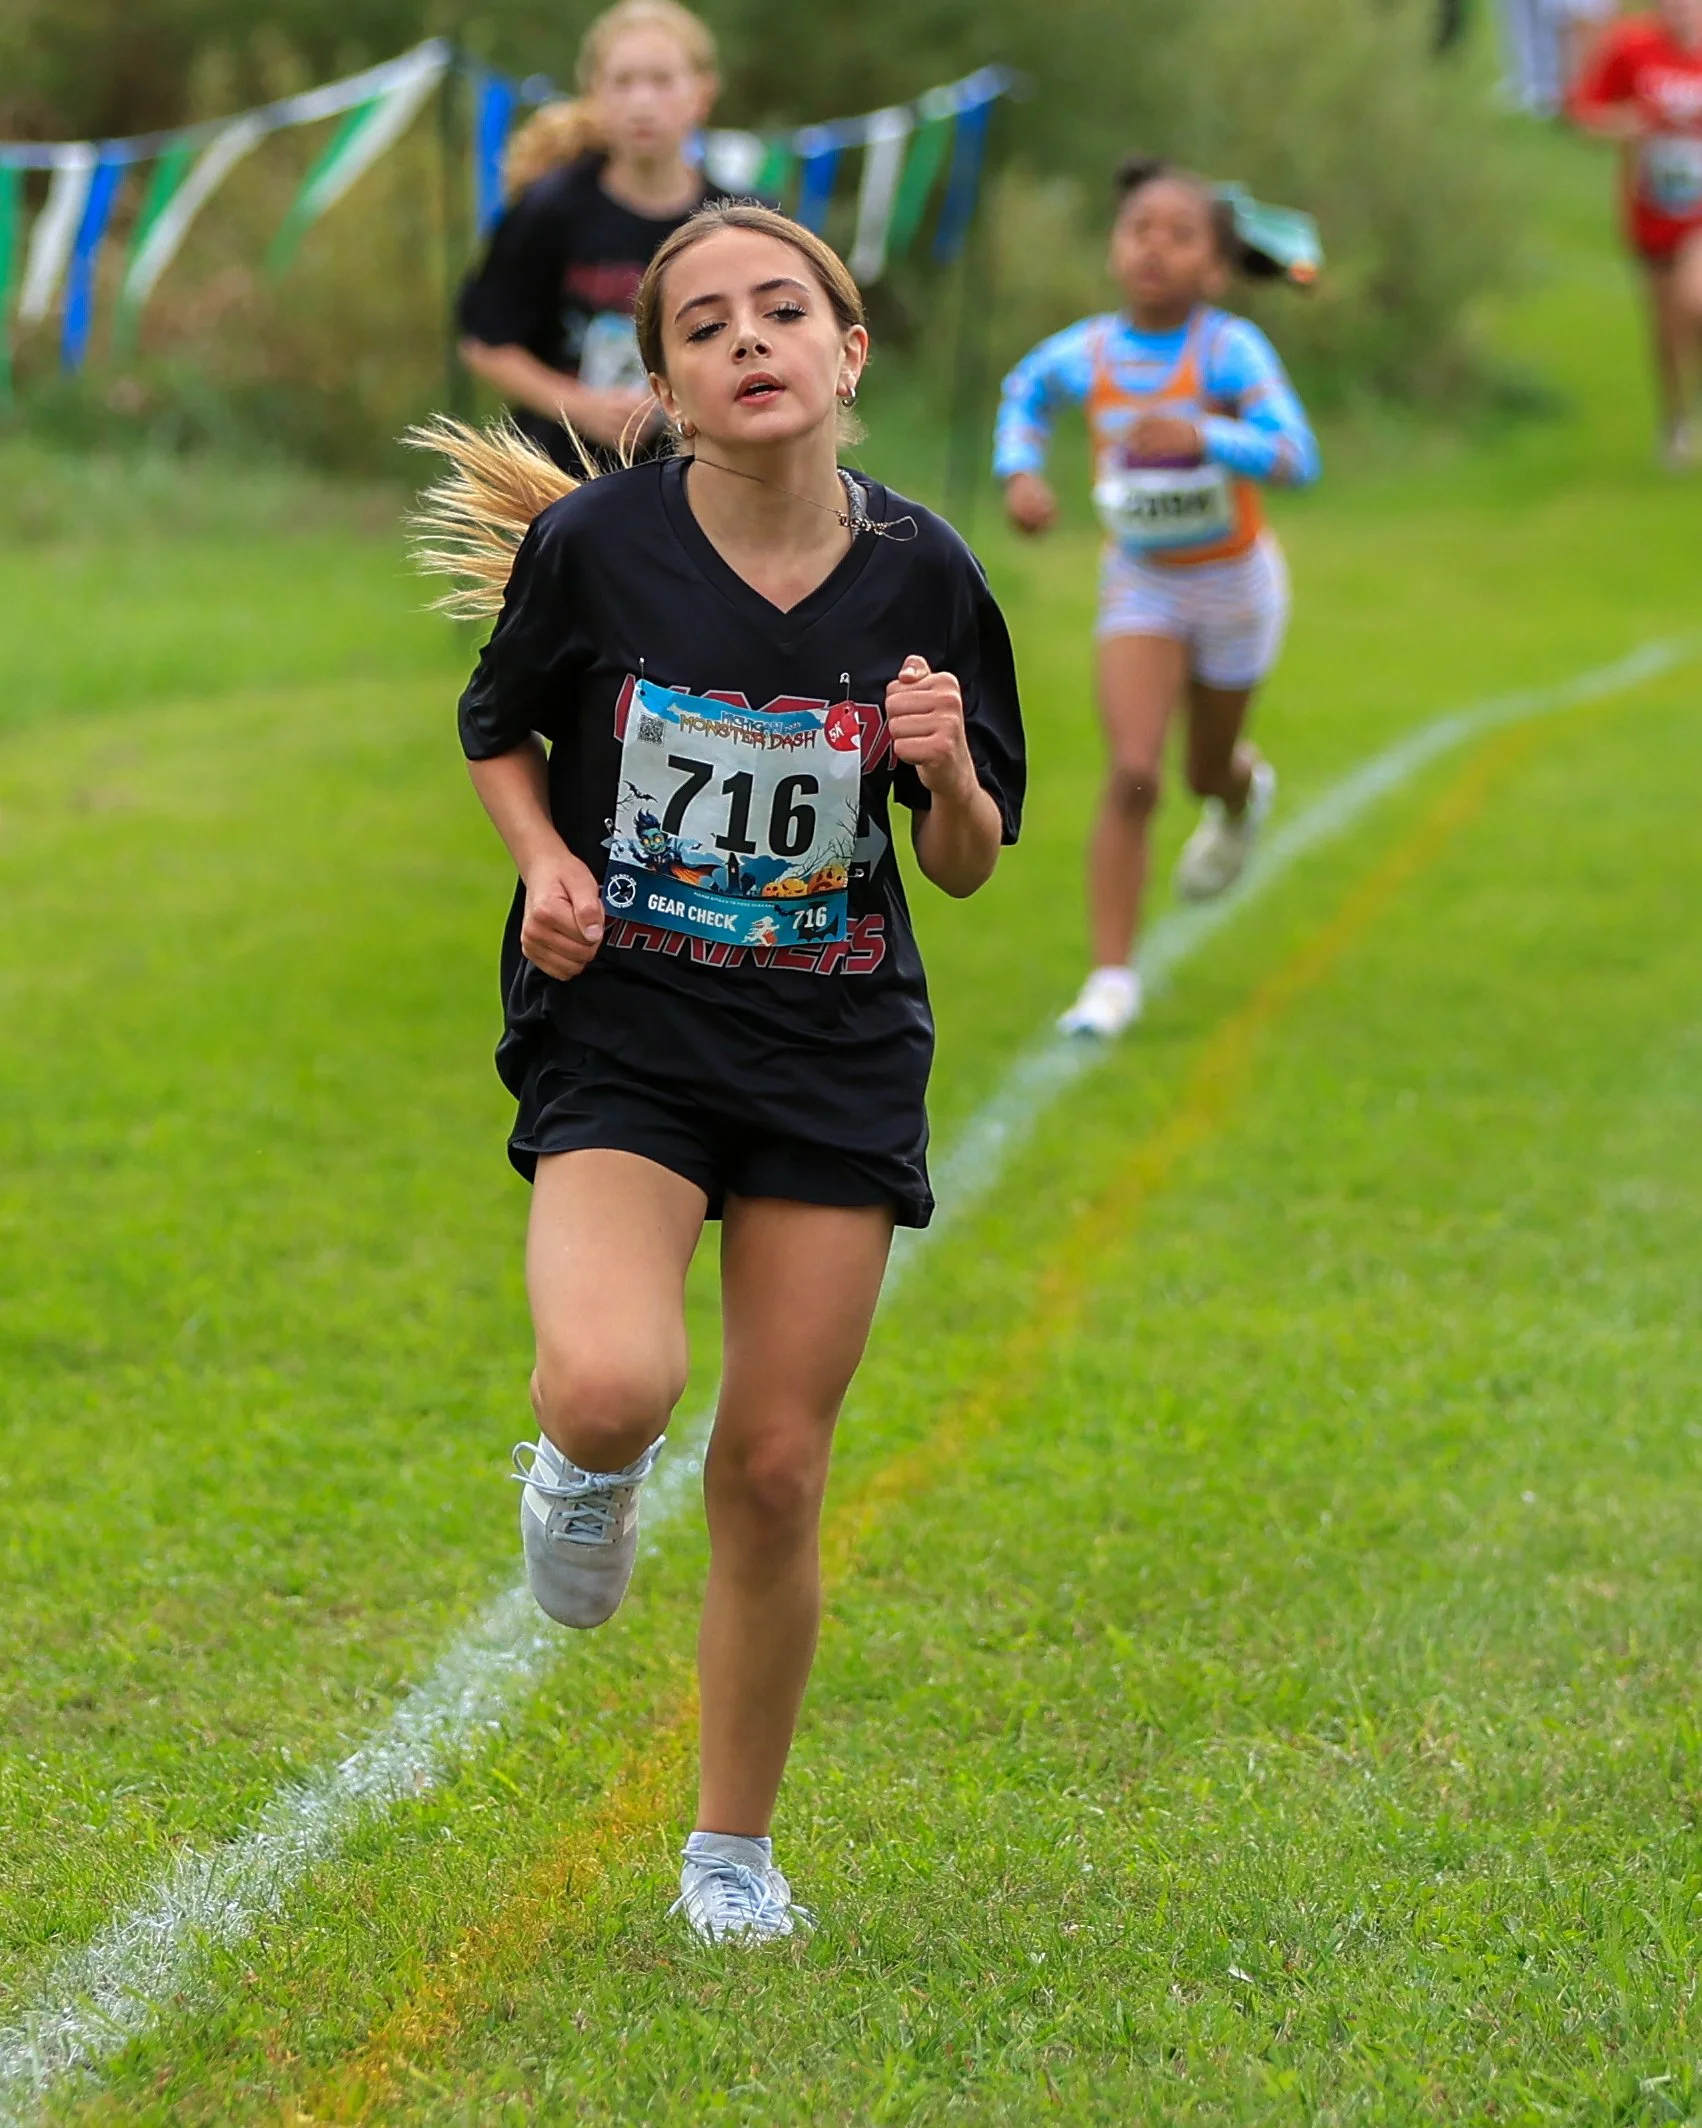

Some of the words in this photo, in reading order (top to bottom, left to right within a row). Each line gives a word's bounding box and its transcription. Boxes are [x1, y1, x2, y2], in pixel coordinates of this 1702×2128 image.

[679, 713, 766, 750] MONSTER
[767, 729, 817, 752] DASH
[661, 753, 820, 858] 716
[647, 893, 686, 918] GEAR
[687, 905, 739, 932] CHECK
[792, 906, 828, 930] 716
